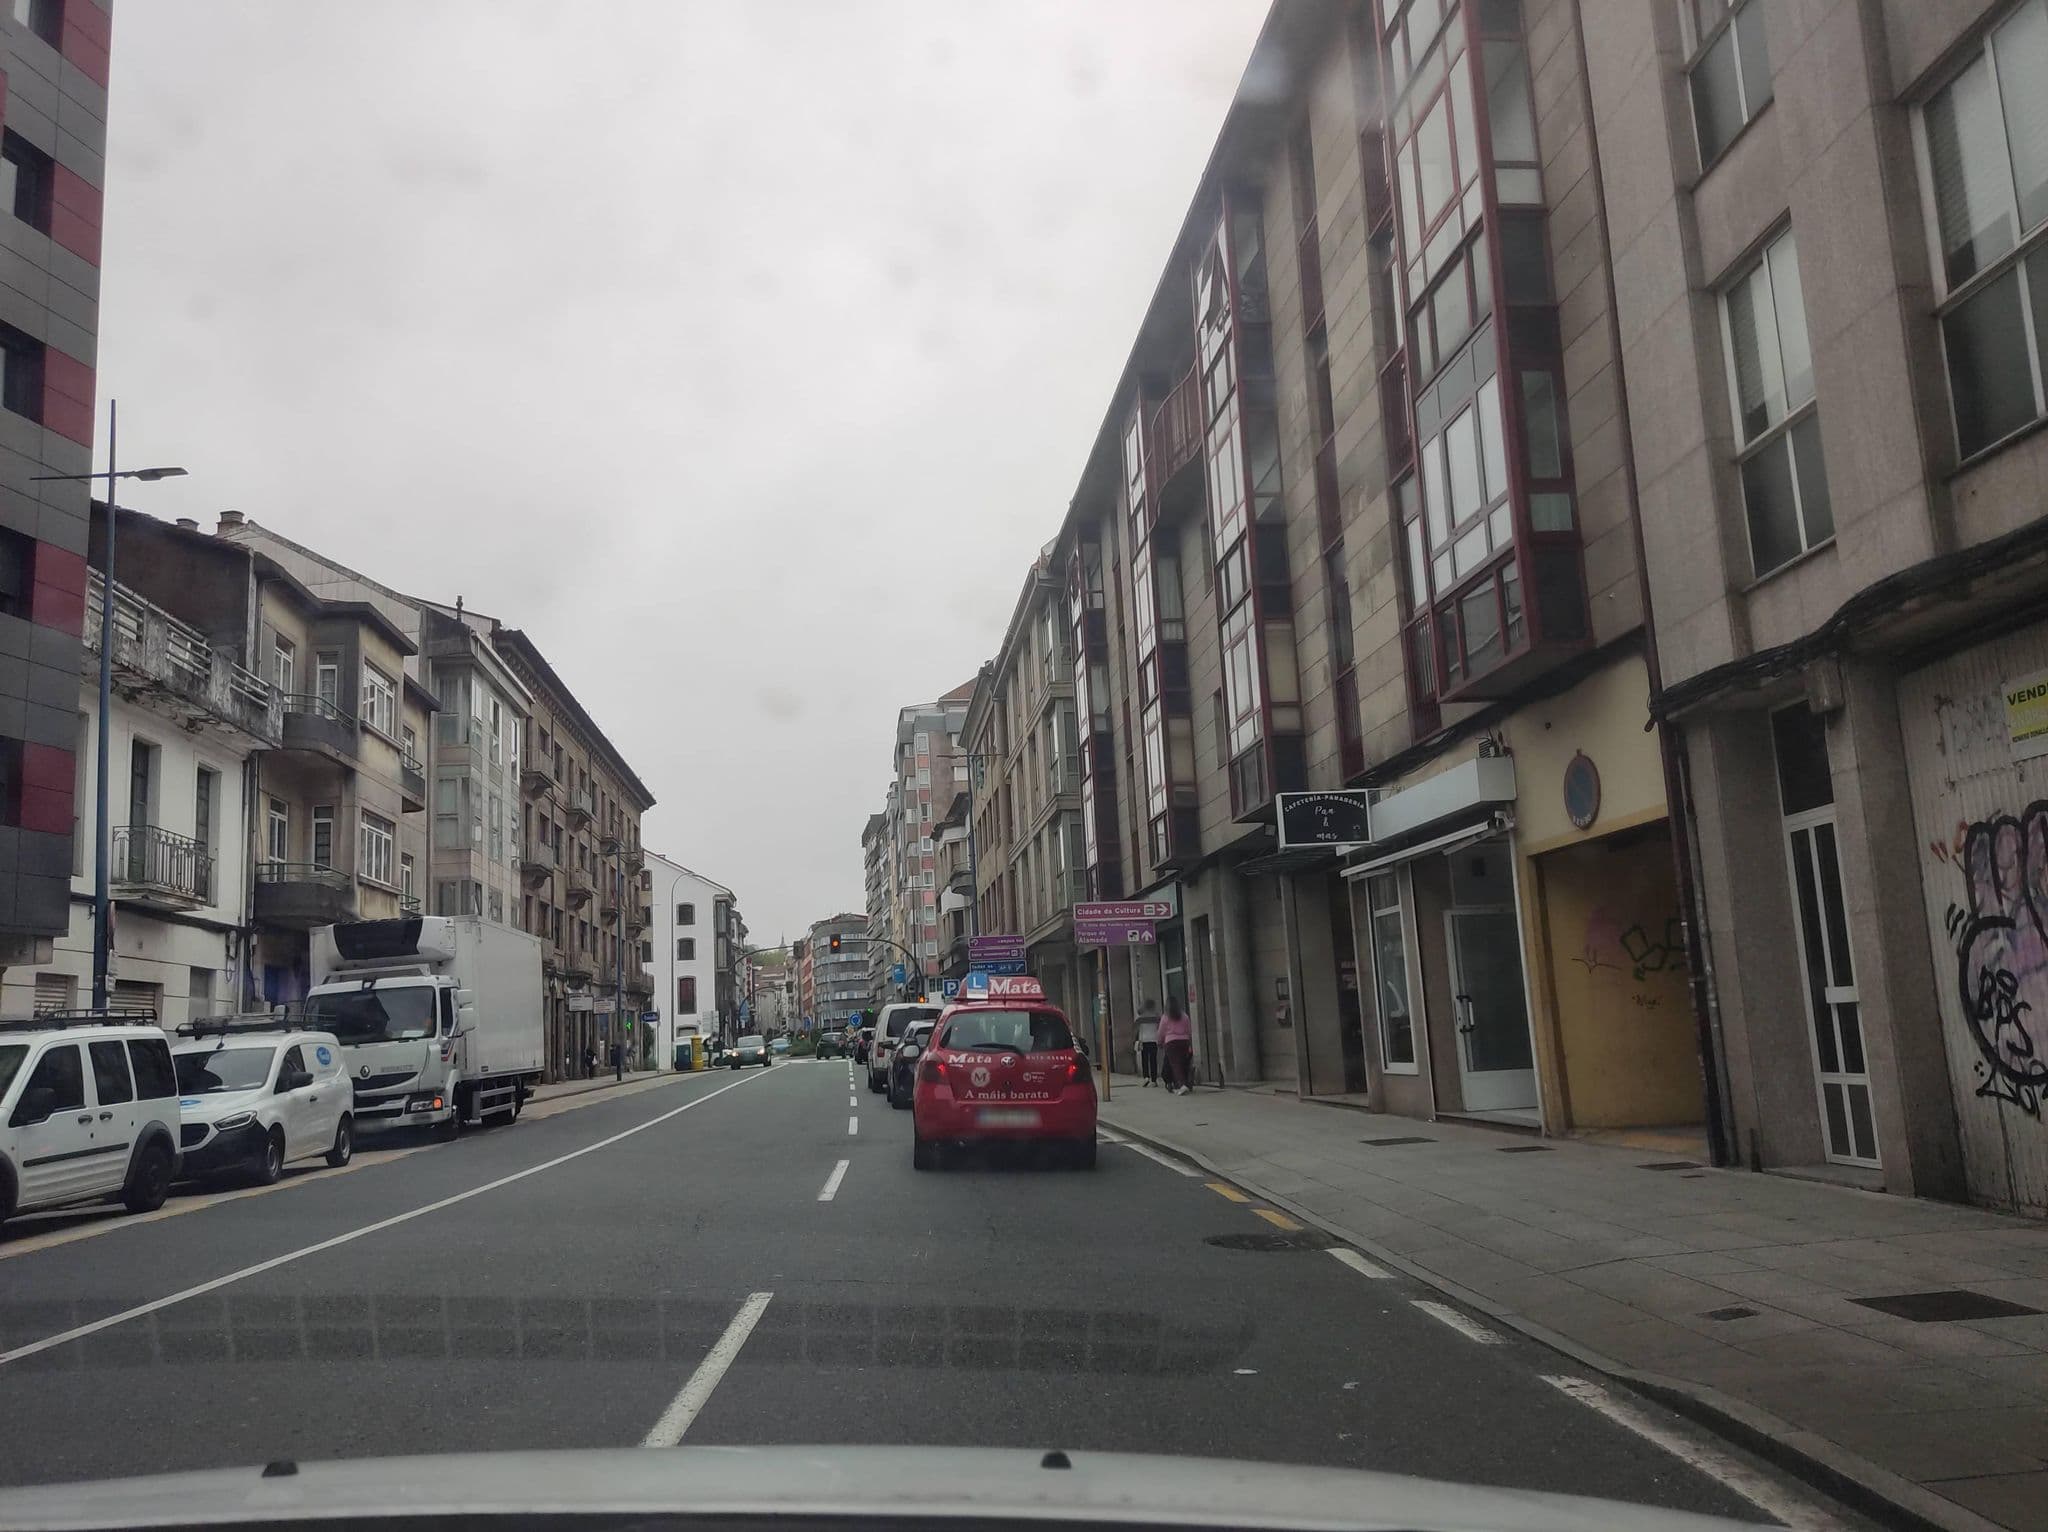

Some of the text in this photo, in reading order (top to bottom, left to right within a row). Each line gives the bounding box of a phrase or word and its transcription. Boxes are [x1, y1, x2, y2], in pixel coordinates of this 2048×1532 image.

[2006, 682, 2048, 705] VEND
[1314, 805, 1334, 816] Pan
[1077, 908, 1102, 916] Cidade
[1114, 907, 1141, 915] Cultura
[1078, 936, 1108, 944] Alameda
[972, 976, 982, 988] L
[988, 978, 1042, 995] Mata
[947, 982, 957, 994] P
[948, 1053, 992, 1064] Mata
[964, 1089, 1049, 1099] A máis barata
